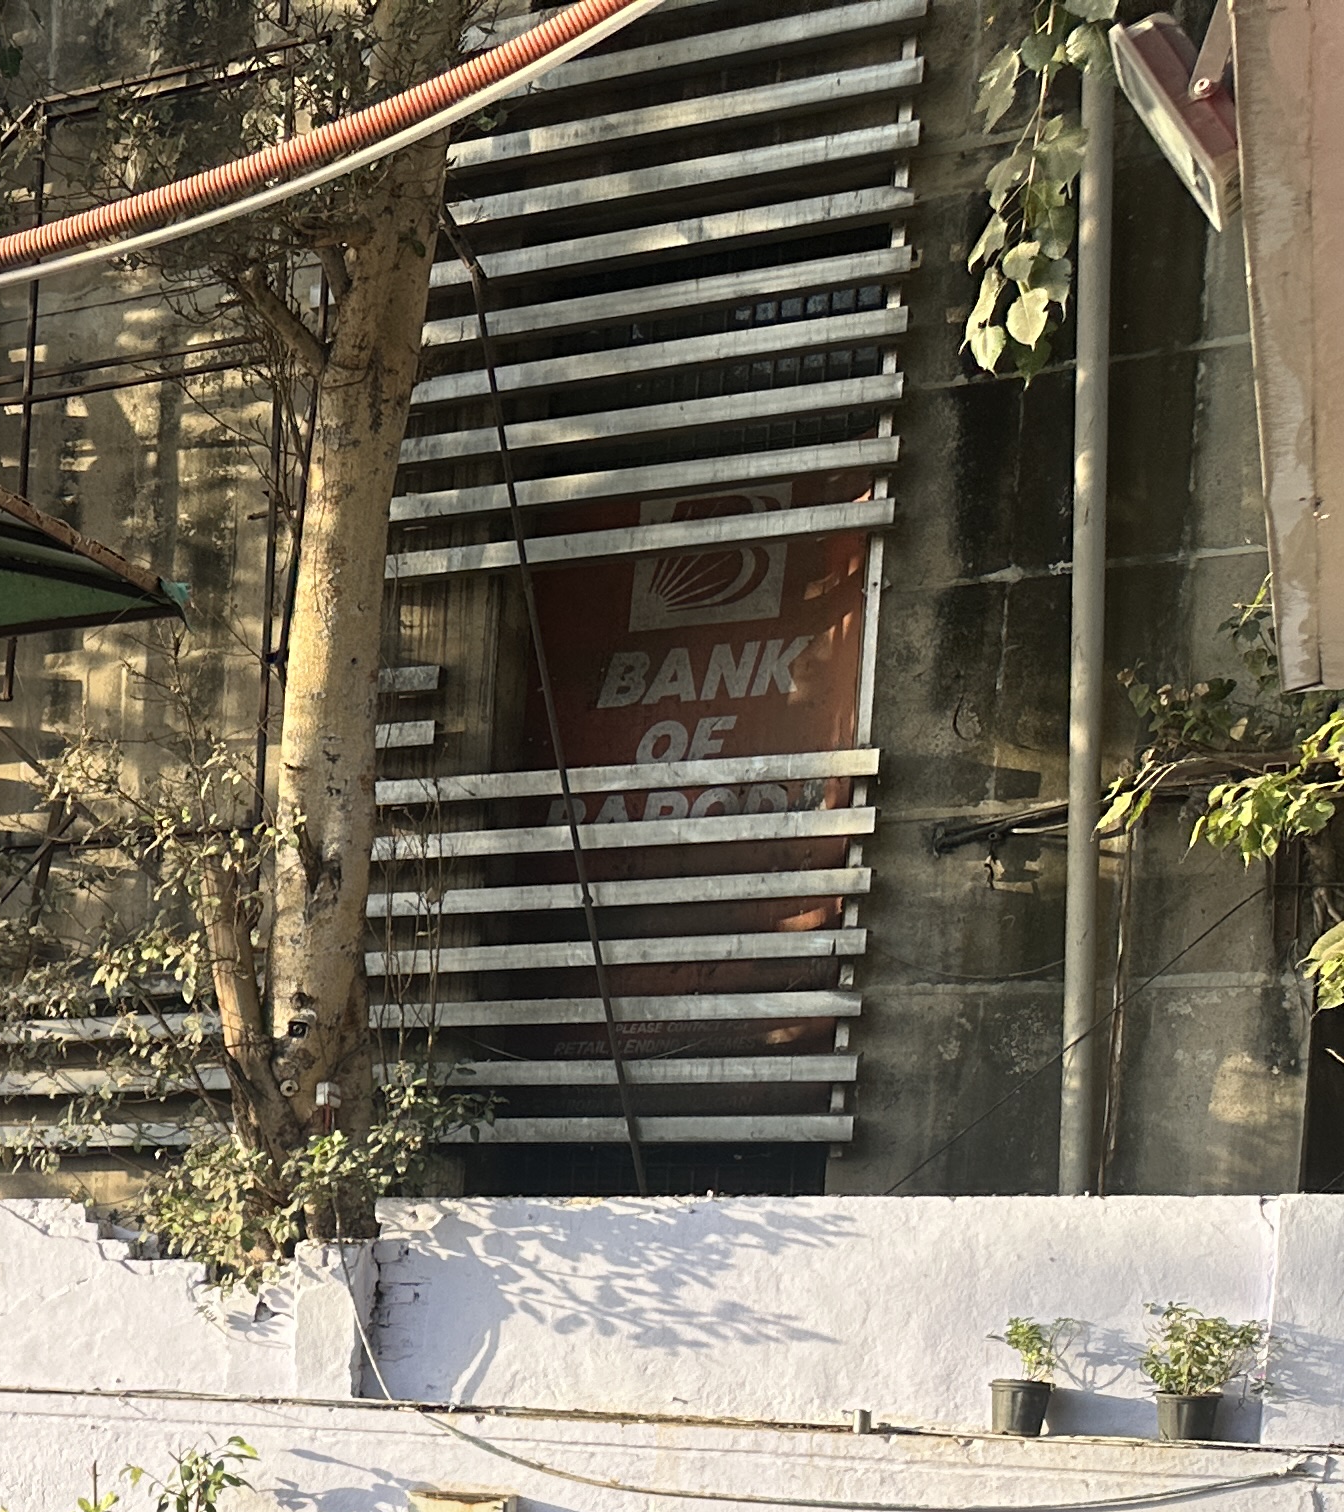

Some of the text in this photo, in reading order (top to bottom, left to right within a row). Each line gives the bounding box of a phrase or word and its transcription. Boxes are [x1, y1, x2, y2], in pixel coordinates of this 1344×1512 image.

[596, 635, 815, 709] BANK
[634, 716, 738, 766] OF
[615, 1022, 663, 1035] PLEASE
